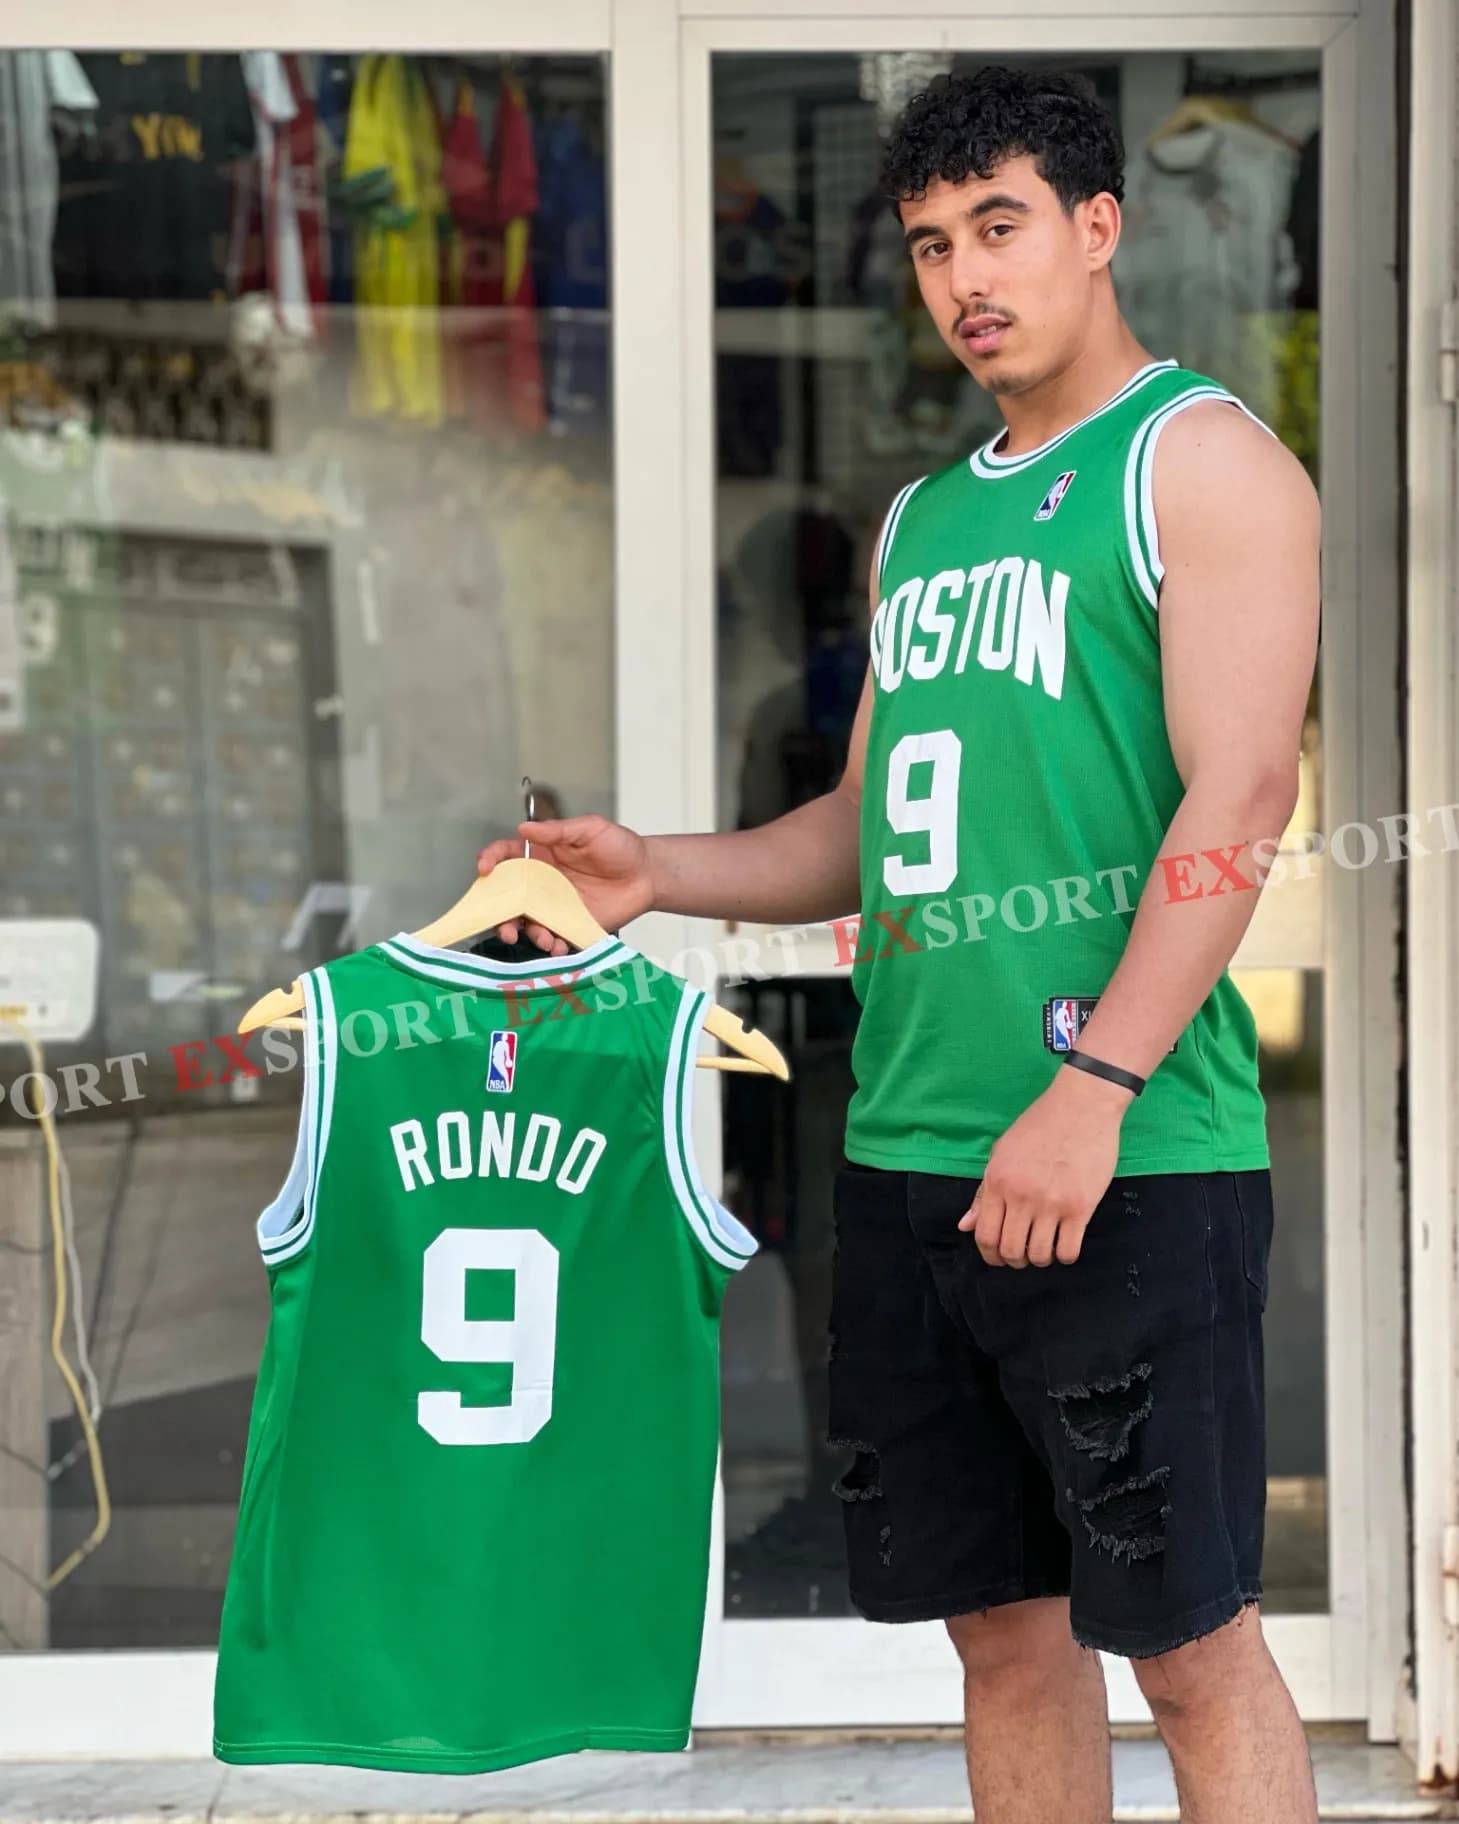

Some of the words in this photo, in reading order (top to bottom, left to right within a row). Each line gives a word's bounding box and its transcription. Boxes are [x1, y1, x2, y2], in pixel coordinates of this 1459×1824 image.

[883, 729, 962, 896] 9
[489, 1080, 506, 1090] NBA
[389, 1110, 607, 1194] RONDO
[417, 1228, 560, 1445] 9
